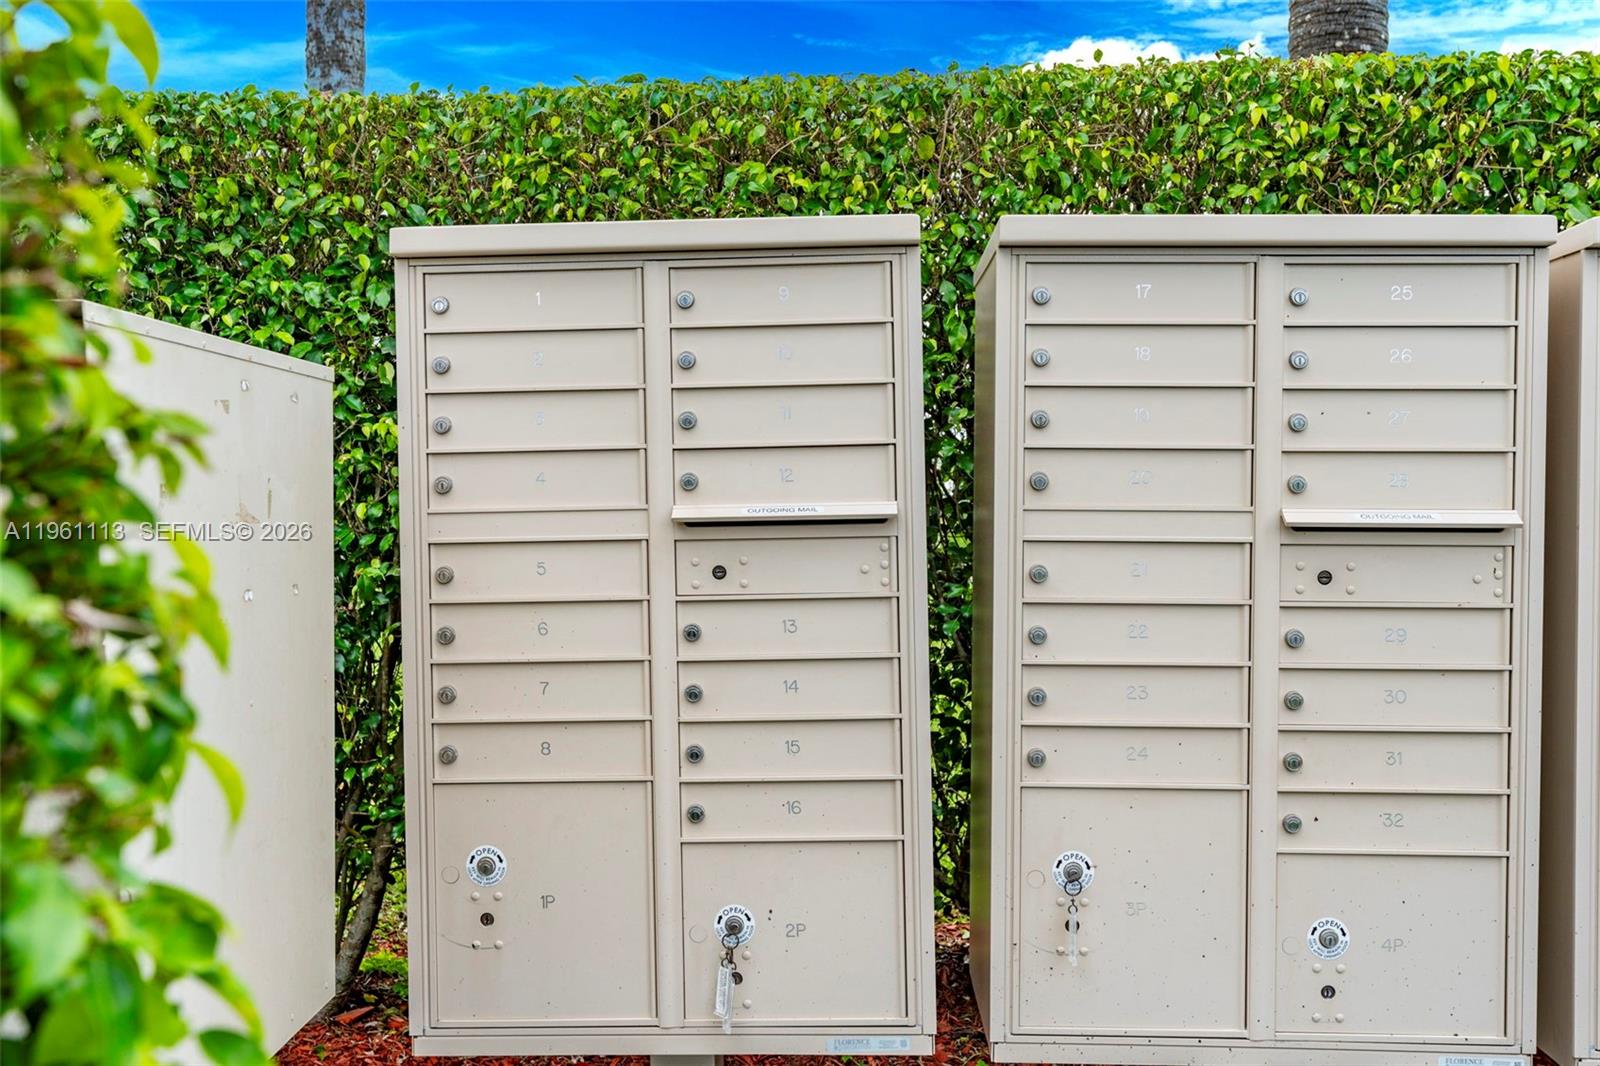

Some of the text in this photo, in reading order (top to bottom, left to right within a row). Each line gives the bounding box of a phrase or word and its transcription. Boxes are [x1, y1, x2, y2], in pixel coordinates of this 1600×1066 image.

[535, 291, 541, 306] 1
[778, 286, 790, 301] 9
[1135, 283, 1152, 299] 17
[1390, 285, 1413, 301] 25
[533, 352, 544, 367] 2
[1135, 346, 1151, 361] 18
[1389, 348, 1412, 363] 26
[1134, 407, 1151, 422] 19
[1389, 410, 1411, 425] 27
[535, 471, 547, 483] 4
[779, 467, 795, 483] 12
[1130, 470, 1152, 485] 20
[535, 561, 547, 577] 5
[537, 621, 549, 637] 6
[782, 618, 798, 634] 13
[1127, 624, 1149, 639] 22
[1384, 628, 1407, 644] 29
[538, 681, 550, 696] 7
[783, 679, 800, 694] 14
[1126, 685, 1149, 700] 23
[1383, 690, 1408, 705] 30
[540, 741, 553, 756] 8
[784, 739, 801, 754] 15
[1126, 746, 1149, 761] 24
[1385, 751, 1402, 766] 31
[784, 800, 802, 815] 16
[1382, 812, 1404, 828] 32
[475, 848, 498, 857] OPEN
[1062, 853, 1086, 863] OPEN
[540, 894, 556, 910] 1P
[1126, 901, 1147, 917] 3P
[722, 906, 745, 917] OPEN
[785, 922, 807, 938] 2P
[1317, 920, 1342, 930] OPEN
[1381, 937, 1405, 953] 4P
